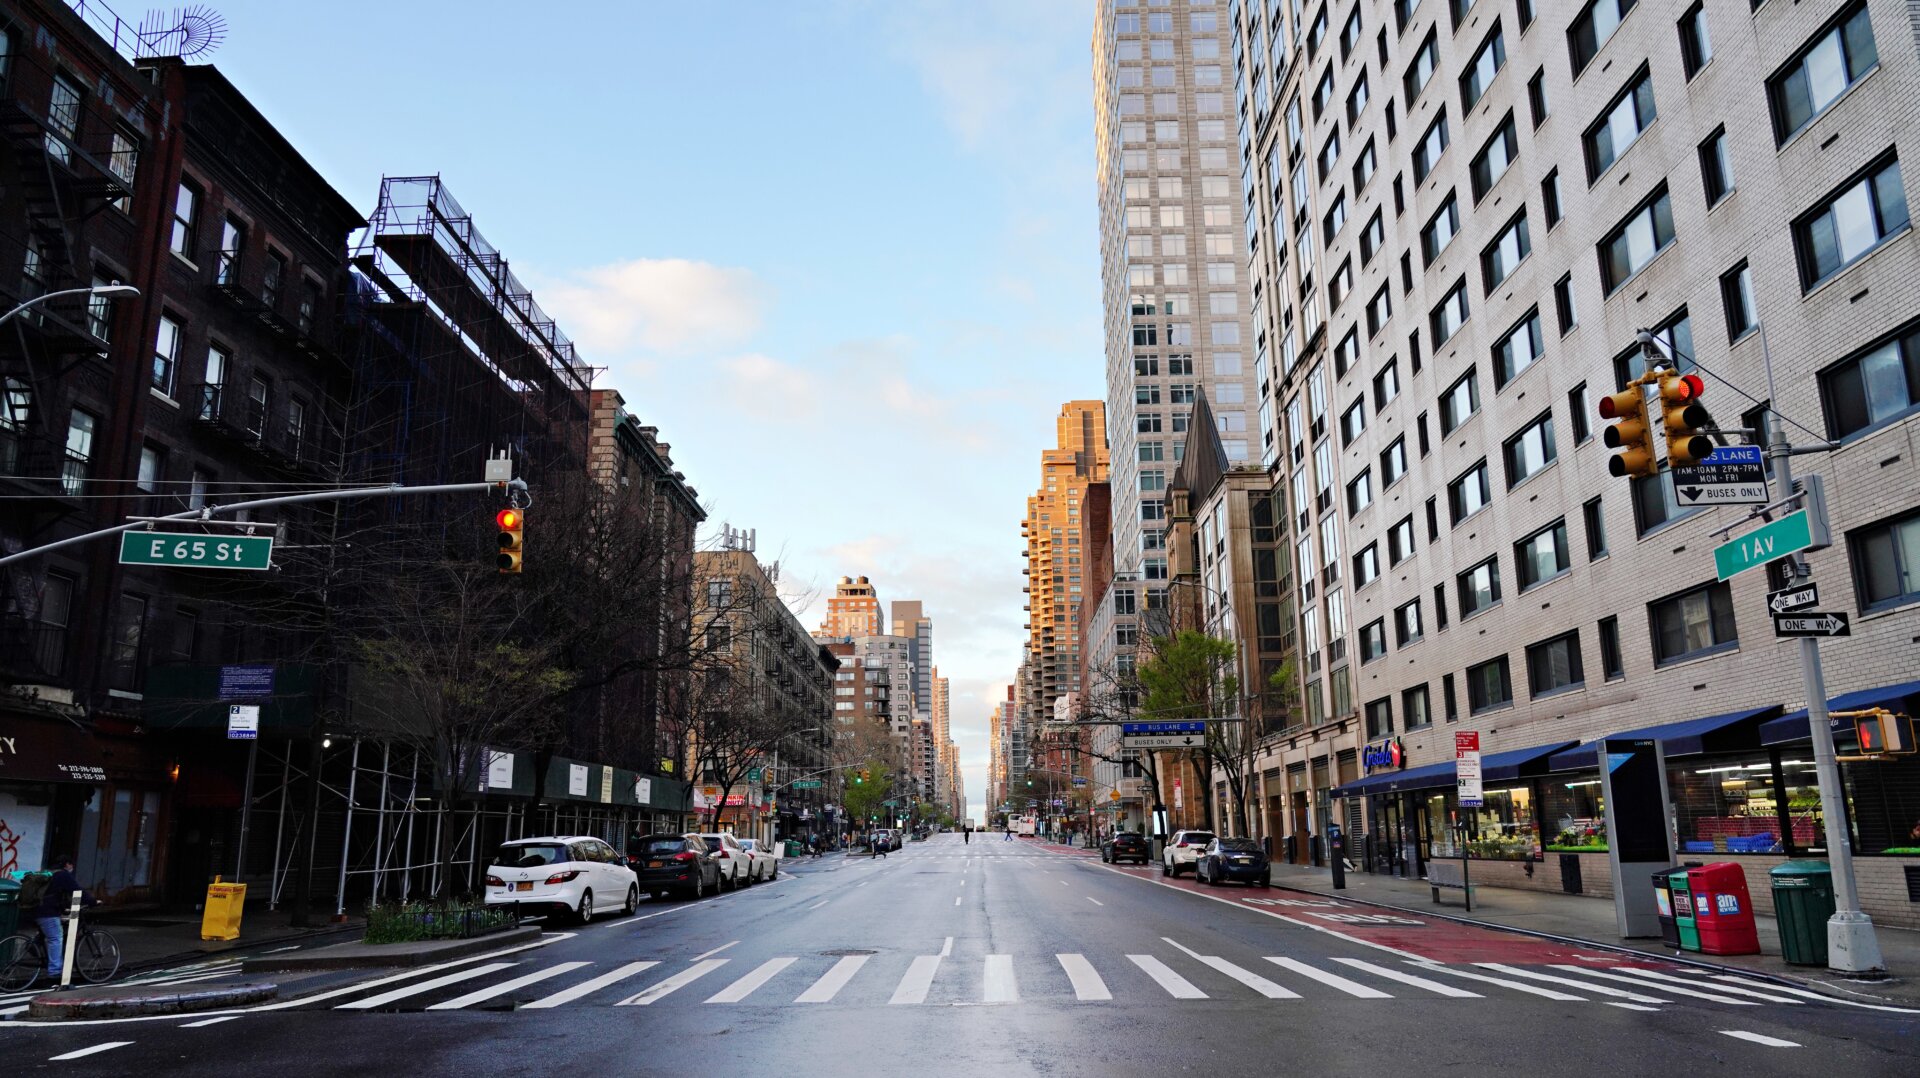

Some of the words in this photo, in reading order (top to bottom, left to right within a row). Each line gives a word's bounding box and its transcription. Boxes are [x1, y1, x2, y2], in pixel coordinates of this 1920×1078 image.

[1721, 450, 1754, 460] LANE
[1722, 464, 1759, 473] 2PM-7PM
[1699, 475, 1718, 483] MON
[1725, 474, 1739, 482] FRI
[1706, 488, 1736, 498] BUSES
[1740, 487, 1763, 498] ONLY
[150, 540, 166, 558] E
[173, 540, 206, 560] 65
[215, 542, 243, 562] St
[1741, 543, 1749, 562] 1
[1753, 535, 1774, 559] Av
[1774, 596, 1789, 609] ONE
[1794, 590, 1811, 604] WAY
[1784, 620, 1807, 630] ONE
[1815, 619, 1838, 630] WAY
[1717, 894, 1737, 908] am
